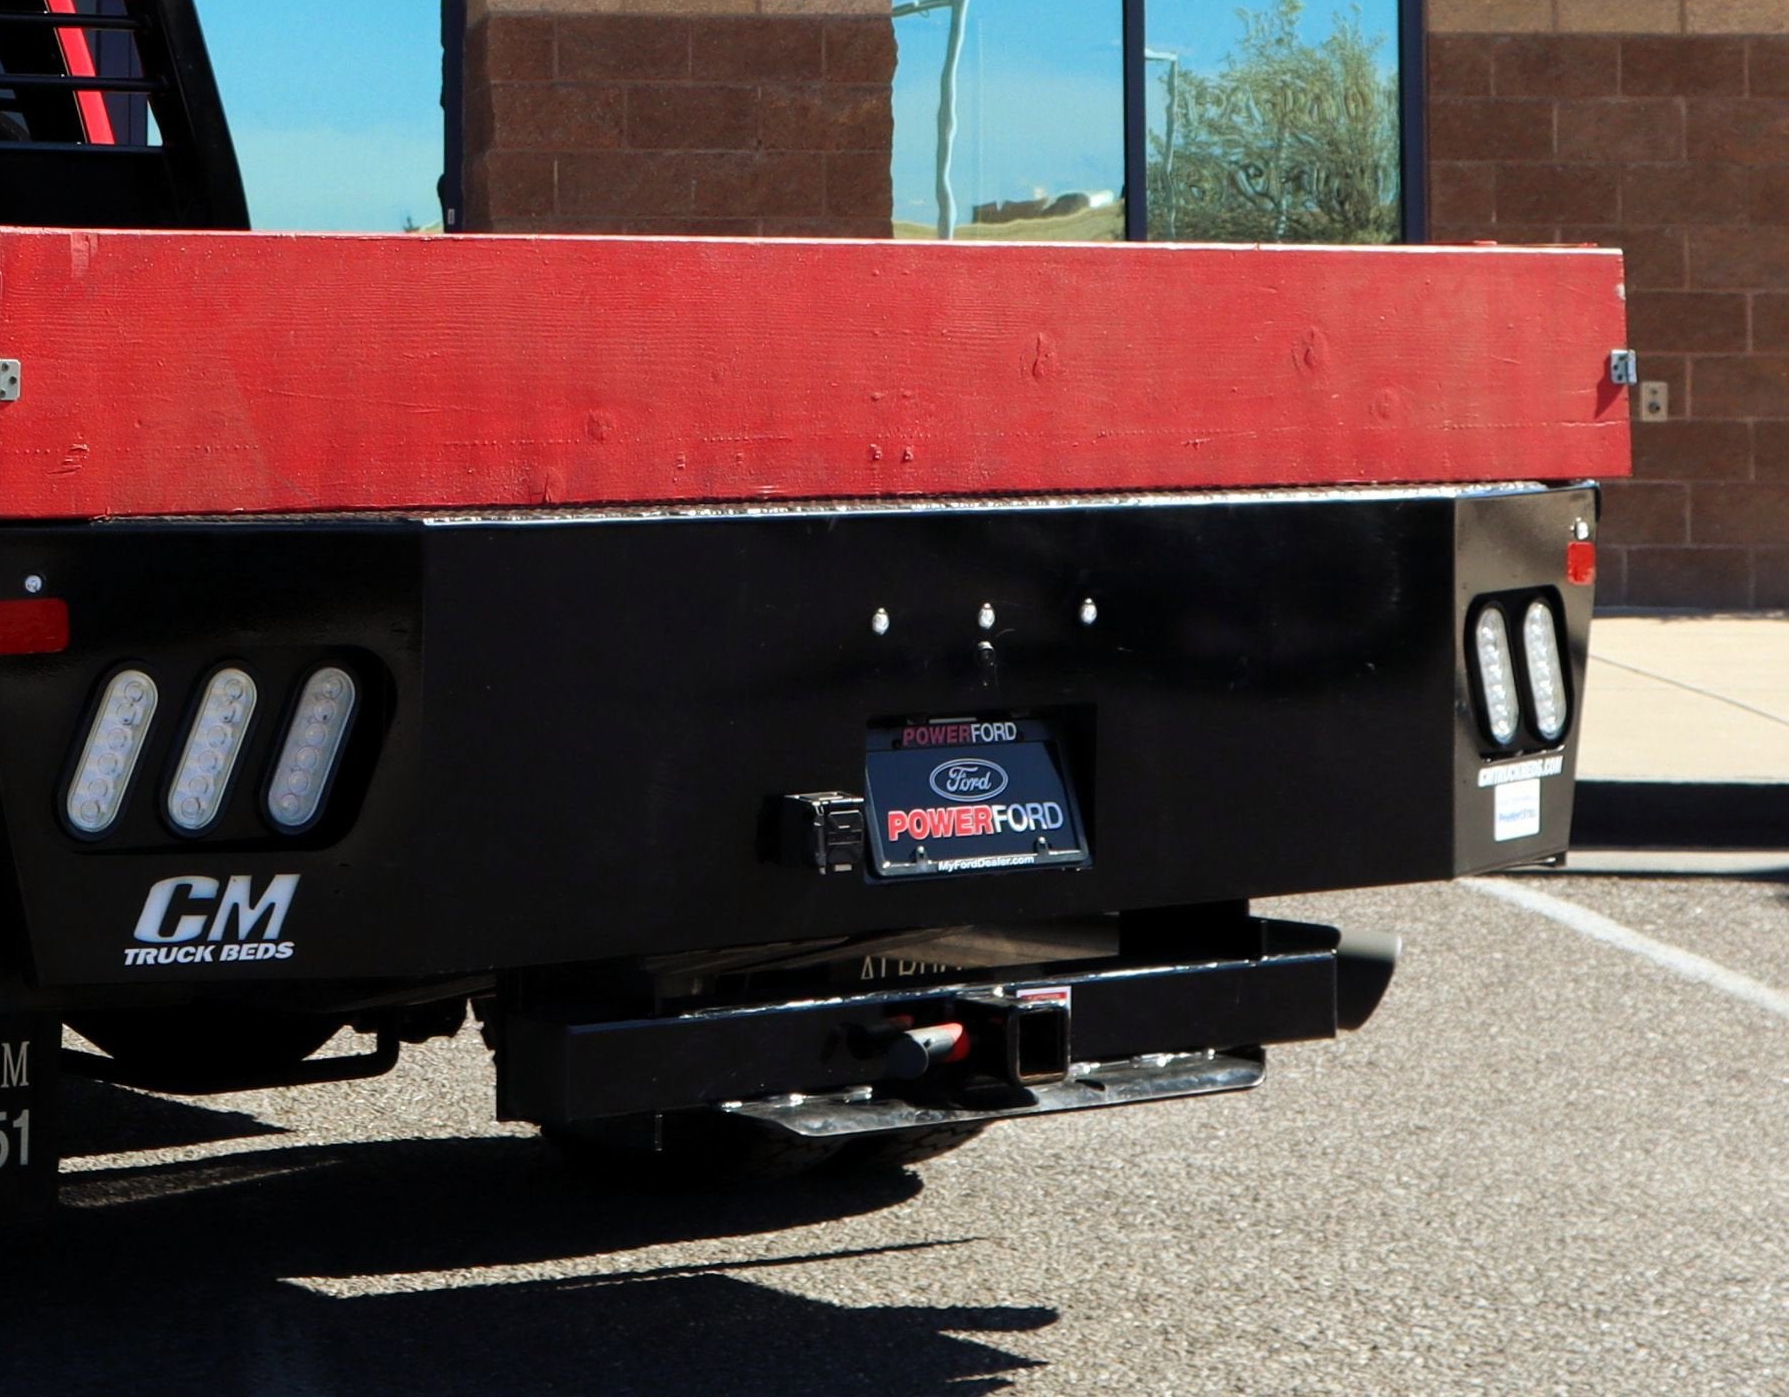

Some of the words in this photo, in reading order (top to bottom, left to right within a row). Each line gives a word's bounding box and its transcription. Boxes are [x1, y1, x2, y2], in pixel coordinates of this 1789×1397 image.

[903, 721, 1017, 746] POWERFORD
[946, 766, 992, 792] Ford
[887, 801, 1063, 841] POWERFORD
[938, 855, 1034, 871] MyFordDealer.com
[133, 874, 300, 942] CM
[124, 946, 216, 966] TRUCK
[219, 941, 296, 961] BEDS
